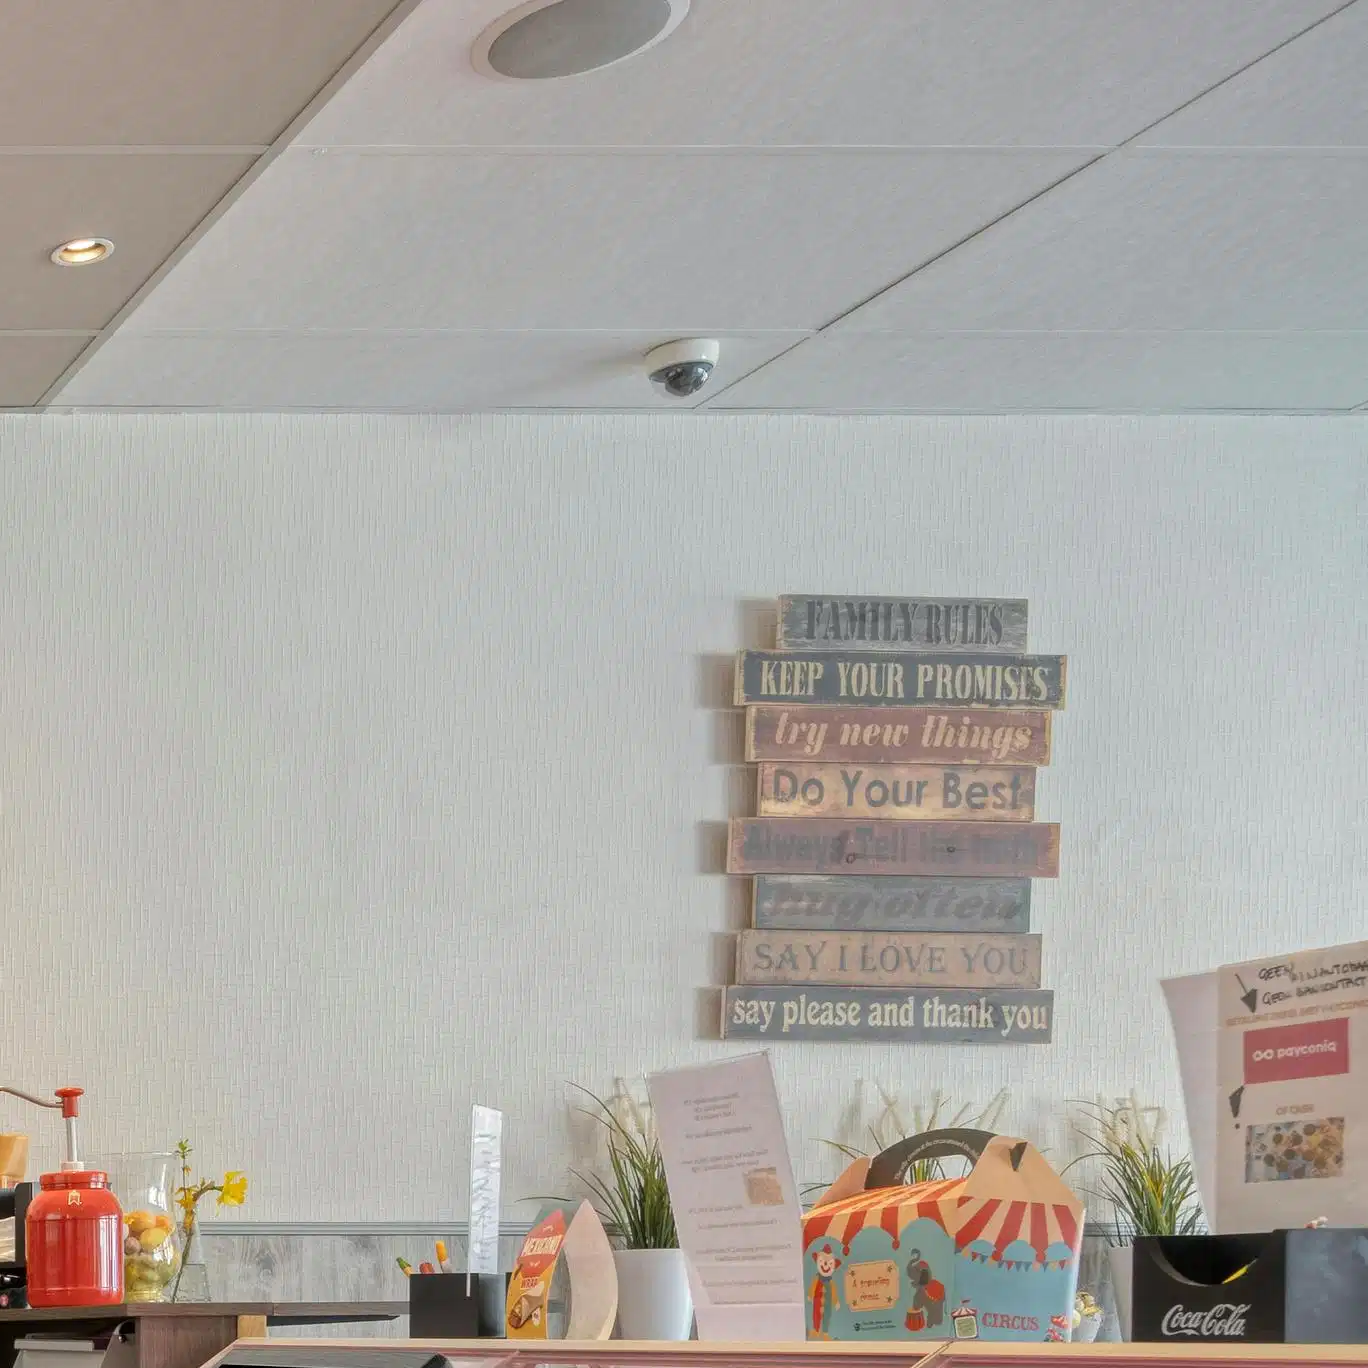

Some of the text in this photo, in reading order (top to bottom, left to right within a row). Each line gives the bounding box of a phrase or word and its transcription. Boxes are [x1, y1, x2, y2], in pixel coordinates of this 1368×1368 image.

[806, 600, 1005, 646] FAMILY RULES
[760, 660, 1050, 702] KEEP YOUR PROMISES
[774, 712, 1032, 759] try new things
[771, 769, 1022, 810] Do Your Best
[754, 940, 1028, 976] SAY I LOVE YOU
[732, 994, 1049, 1037] say please and thank you
[1277, 1039, 1338, 1060] payconiq
[981, 1312, 1040, 1331] CIRCUS
[1161, 1303, 1252, 1337] Coca-Cola
